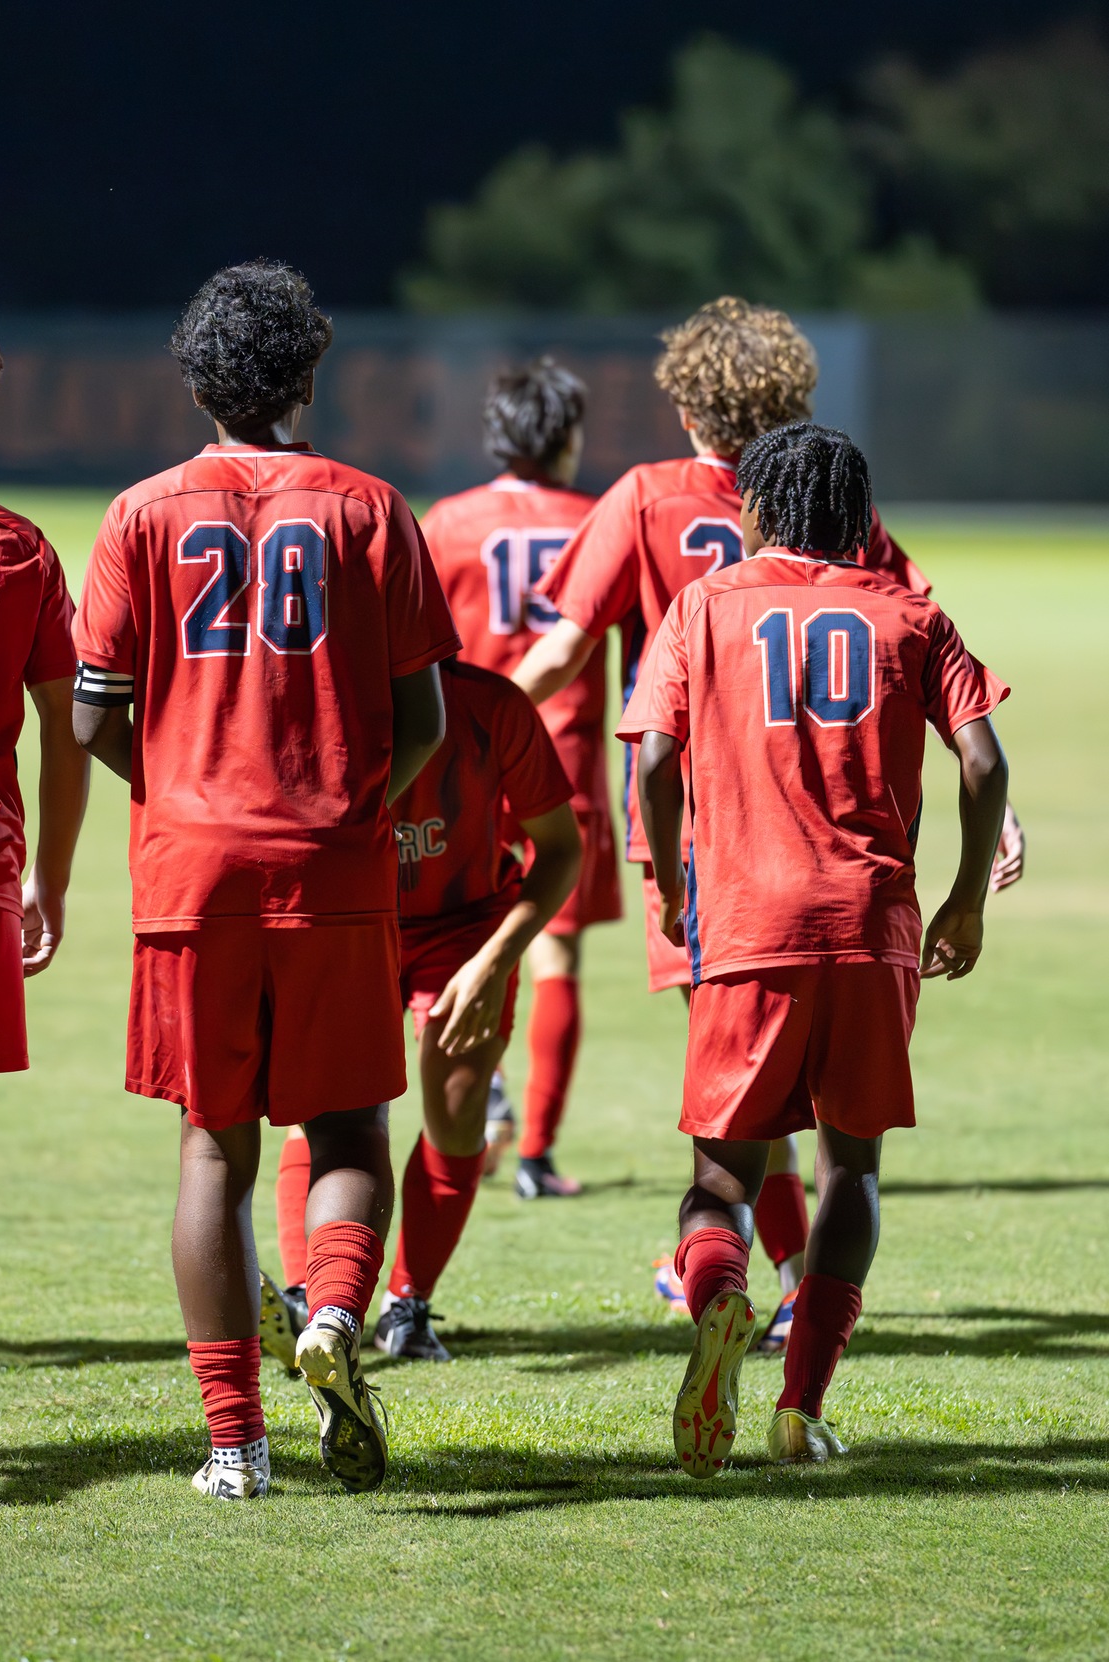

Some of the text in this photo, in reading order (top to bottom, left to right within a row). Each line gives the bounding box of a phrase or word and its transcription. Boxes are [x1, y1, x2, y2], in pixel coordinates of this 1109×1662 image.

[176, 518, 329, 659] 28
[479, 527, 576, 635] 15
[752, 607, 876, 727] 10
